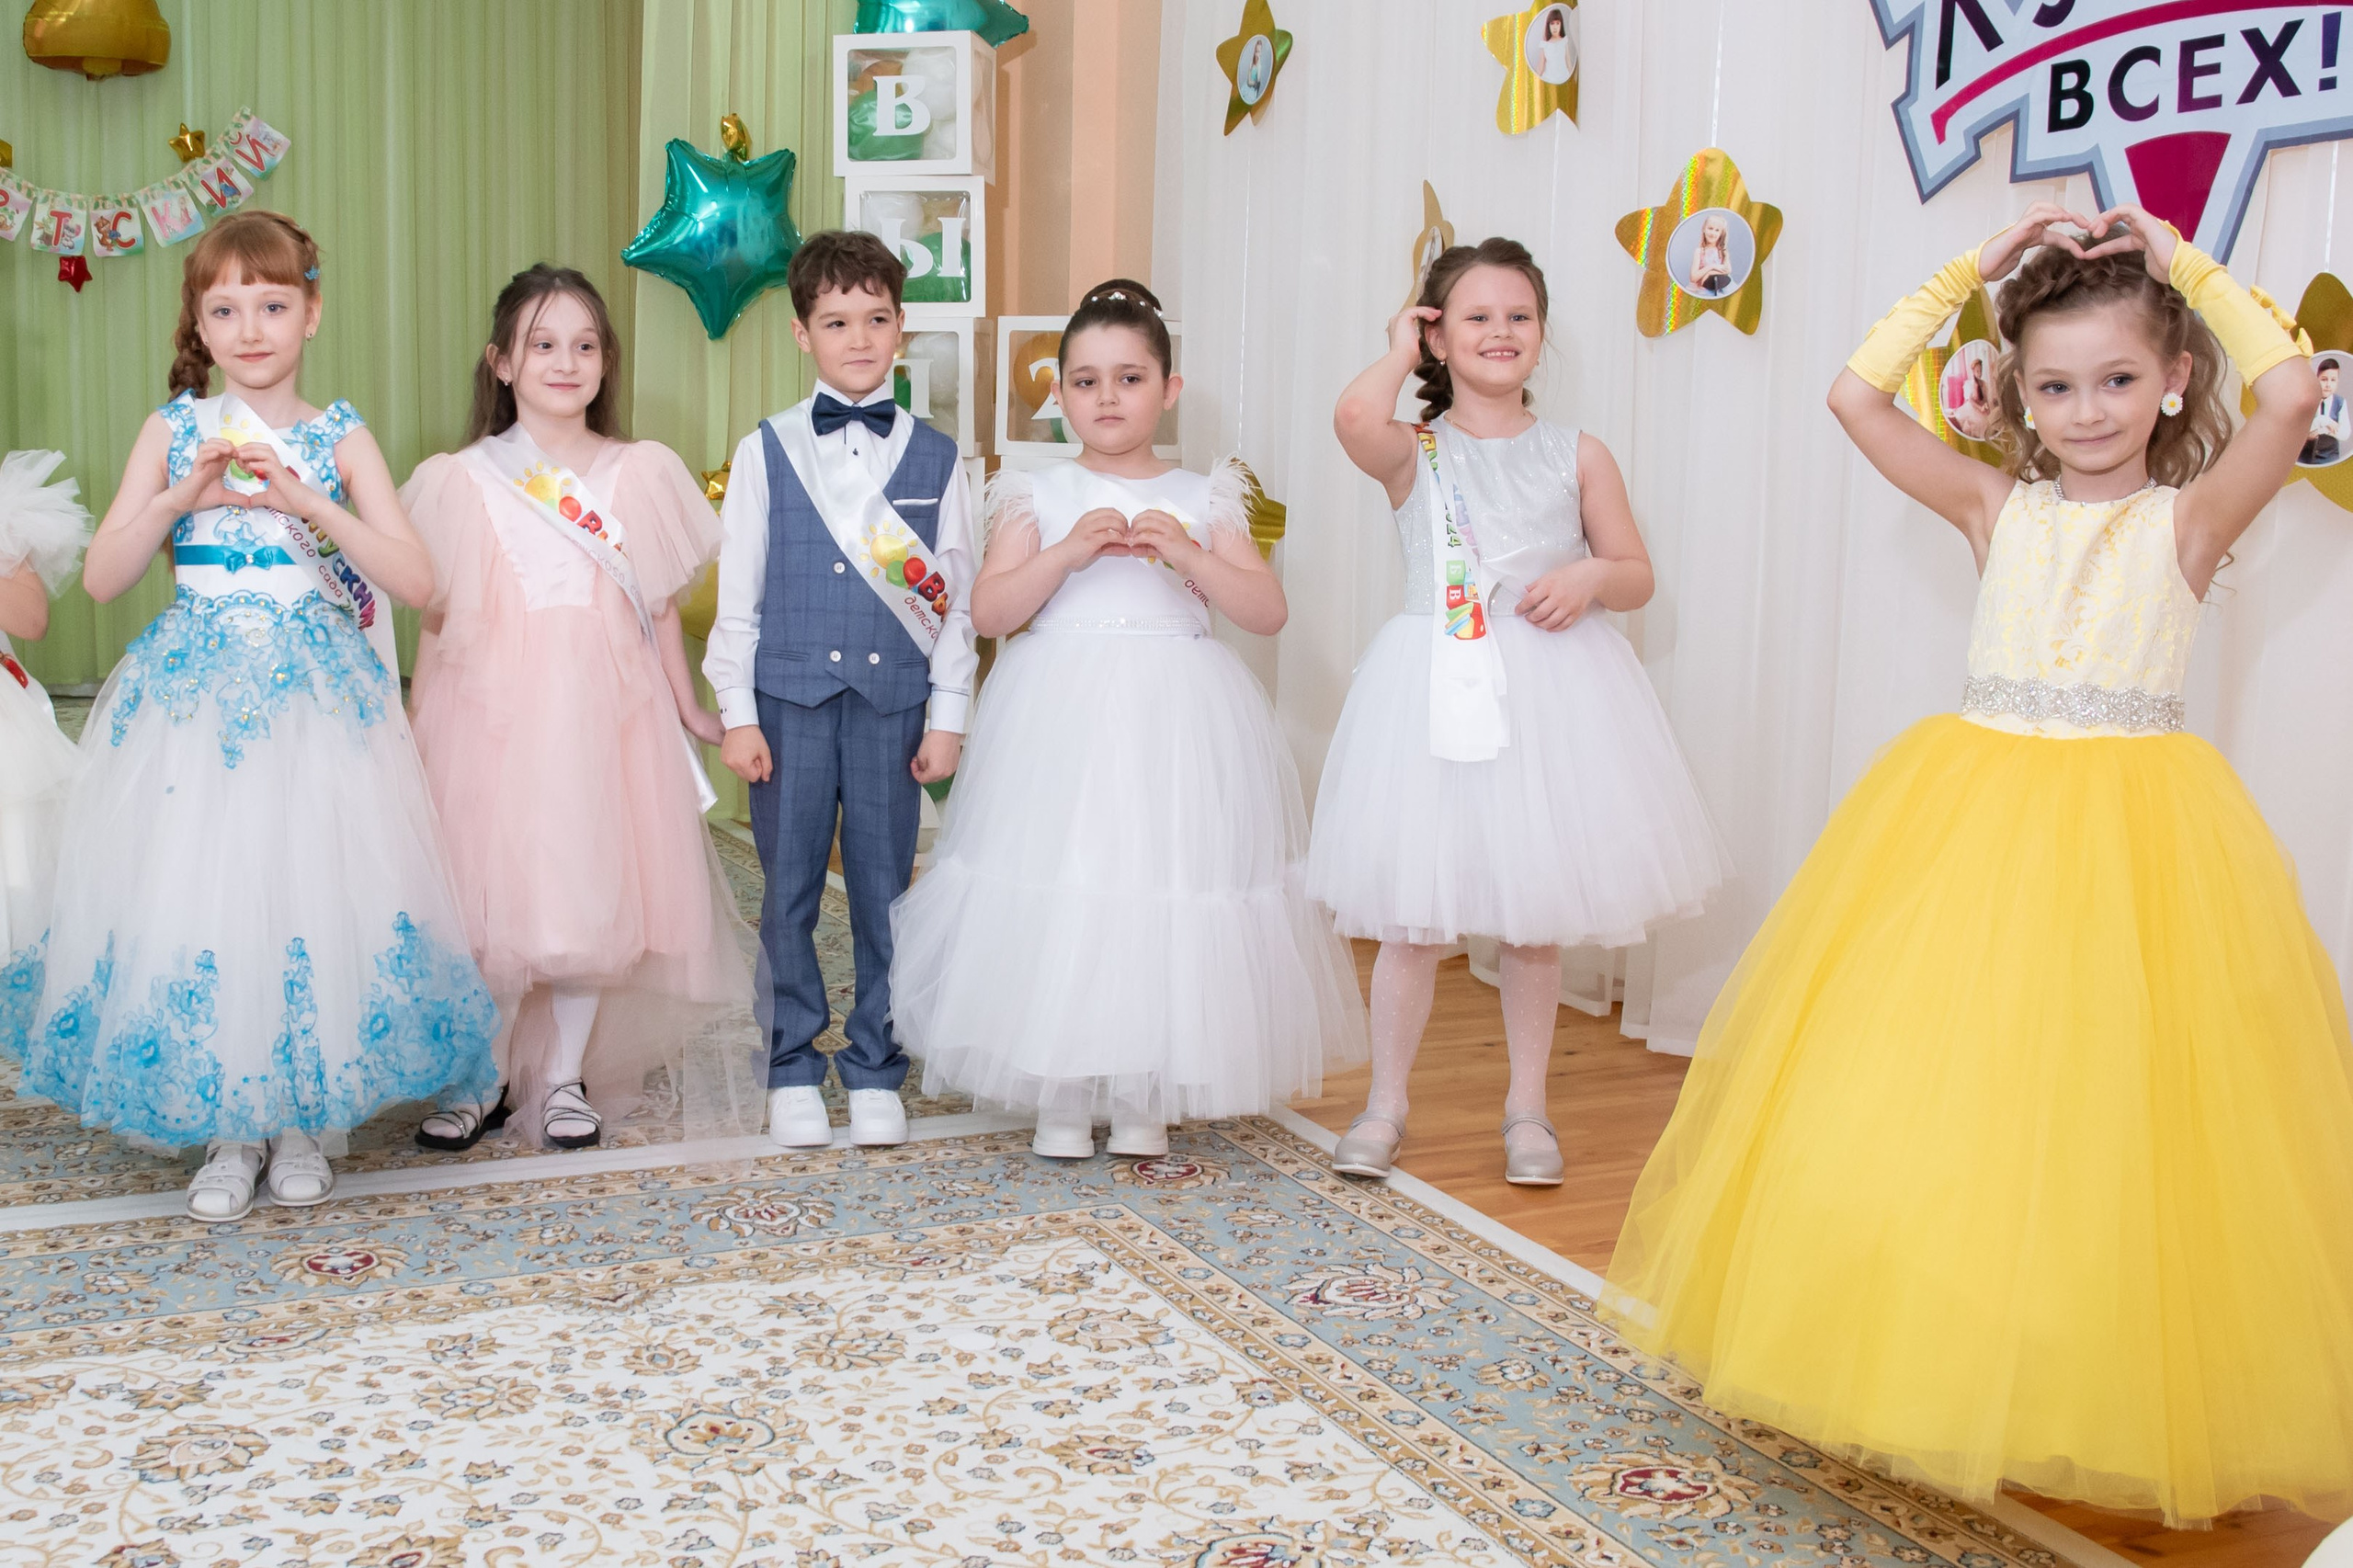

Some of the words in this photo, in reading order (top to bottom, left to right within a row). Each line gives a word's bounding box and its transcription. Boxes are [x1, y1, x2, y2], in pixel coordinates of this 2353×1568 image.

[2048, 12, 2342, 133] ВСЕХ!
[263, 506, 316, 558] тского
[318, 564, 344, 599] сада
